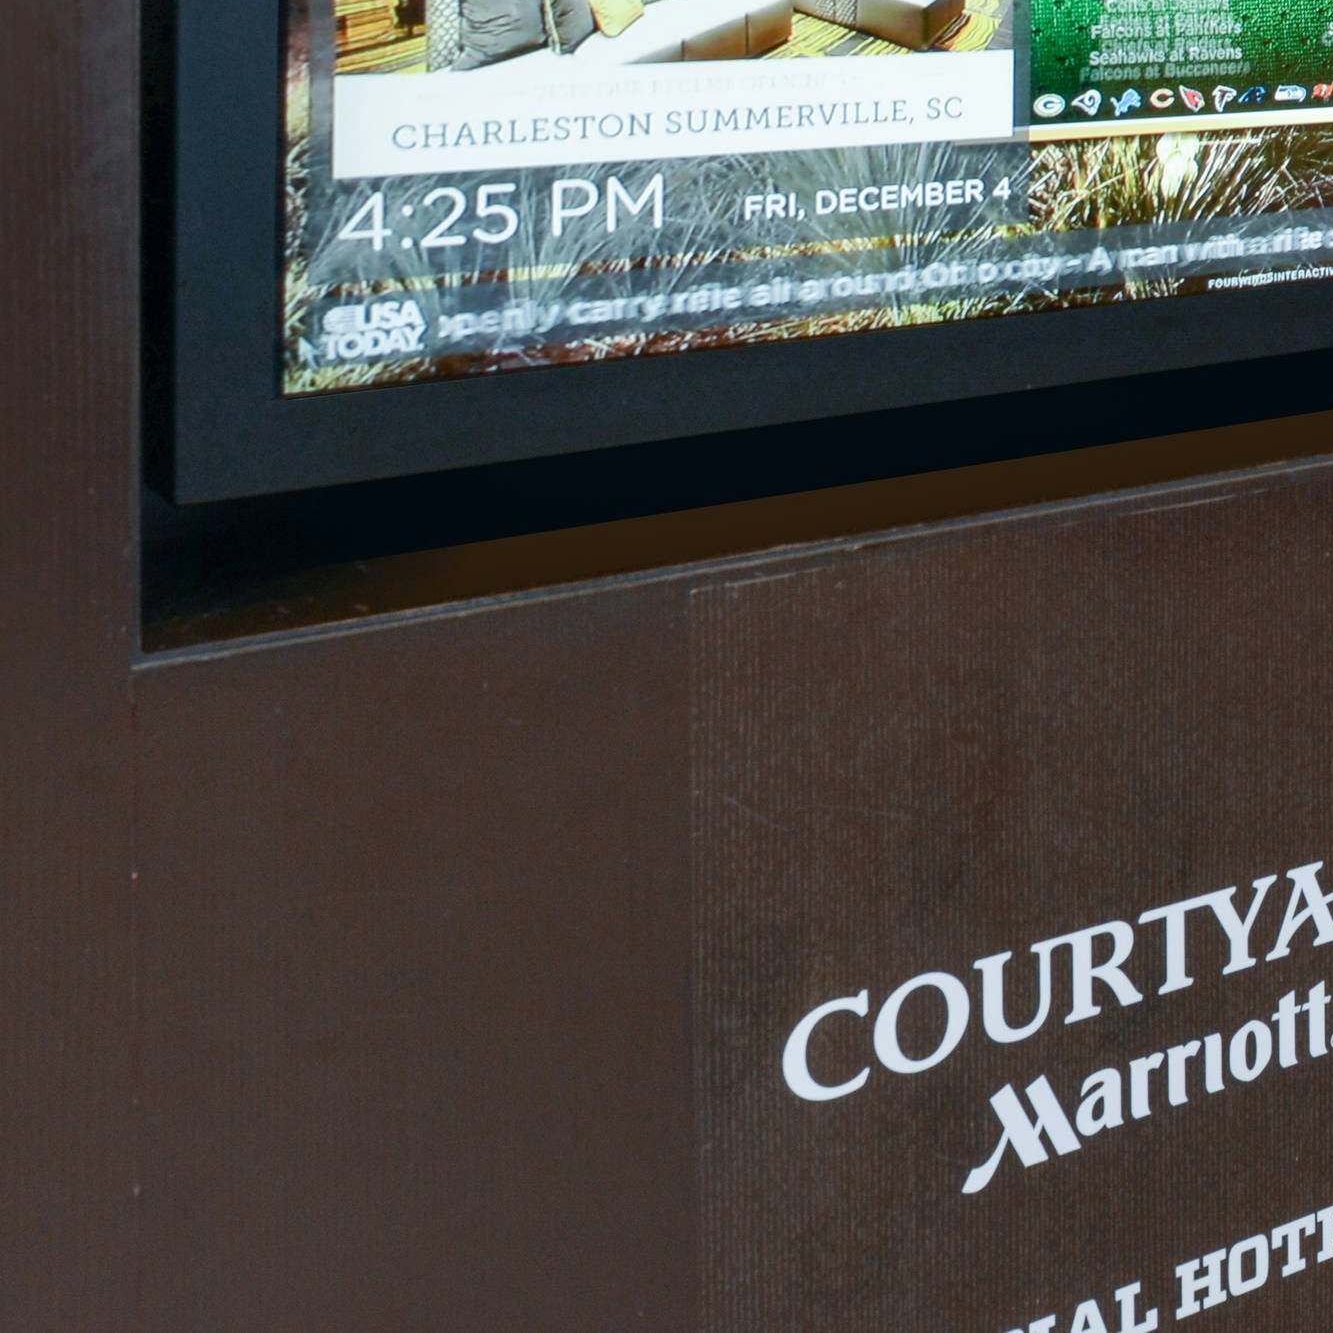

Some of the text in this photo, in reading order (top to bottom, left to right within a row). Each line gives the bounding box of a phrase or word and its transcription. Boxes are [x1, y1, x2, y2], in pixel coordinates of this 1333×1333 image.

[1089, 46, 1242, 65] Seahawks at Ravens
[390, 96, 964, 151] CHARLESTON SUMMERVILLE, SC
[339, 173, 664, 252] 4:25 PM
[744, 179, 1012, 222] FRI, DECEMBER 4
[359, 299, 426, 330] USA
